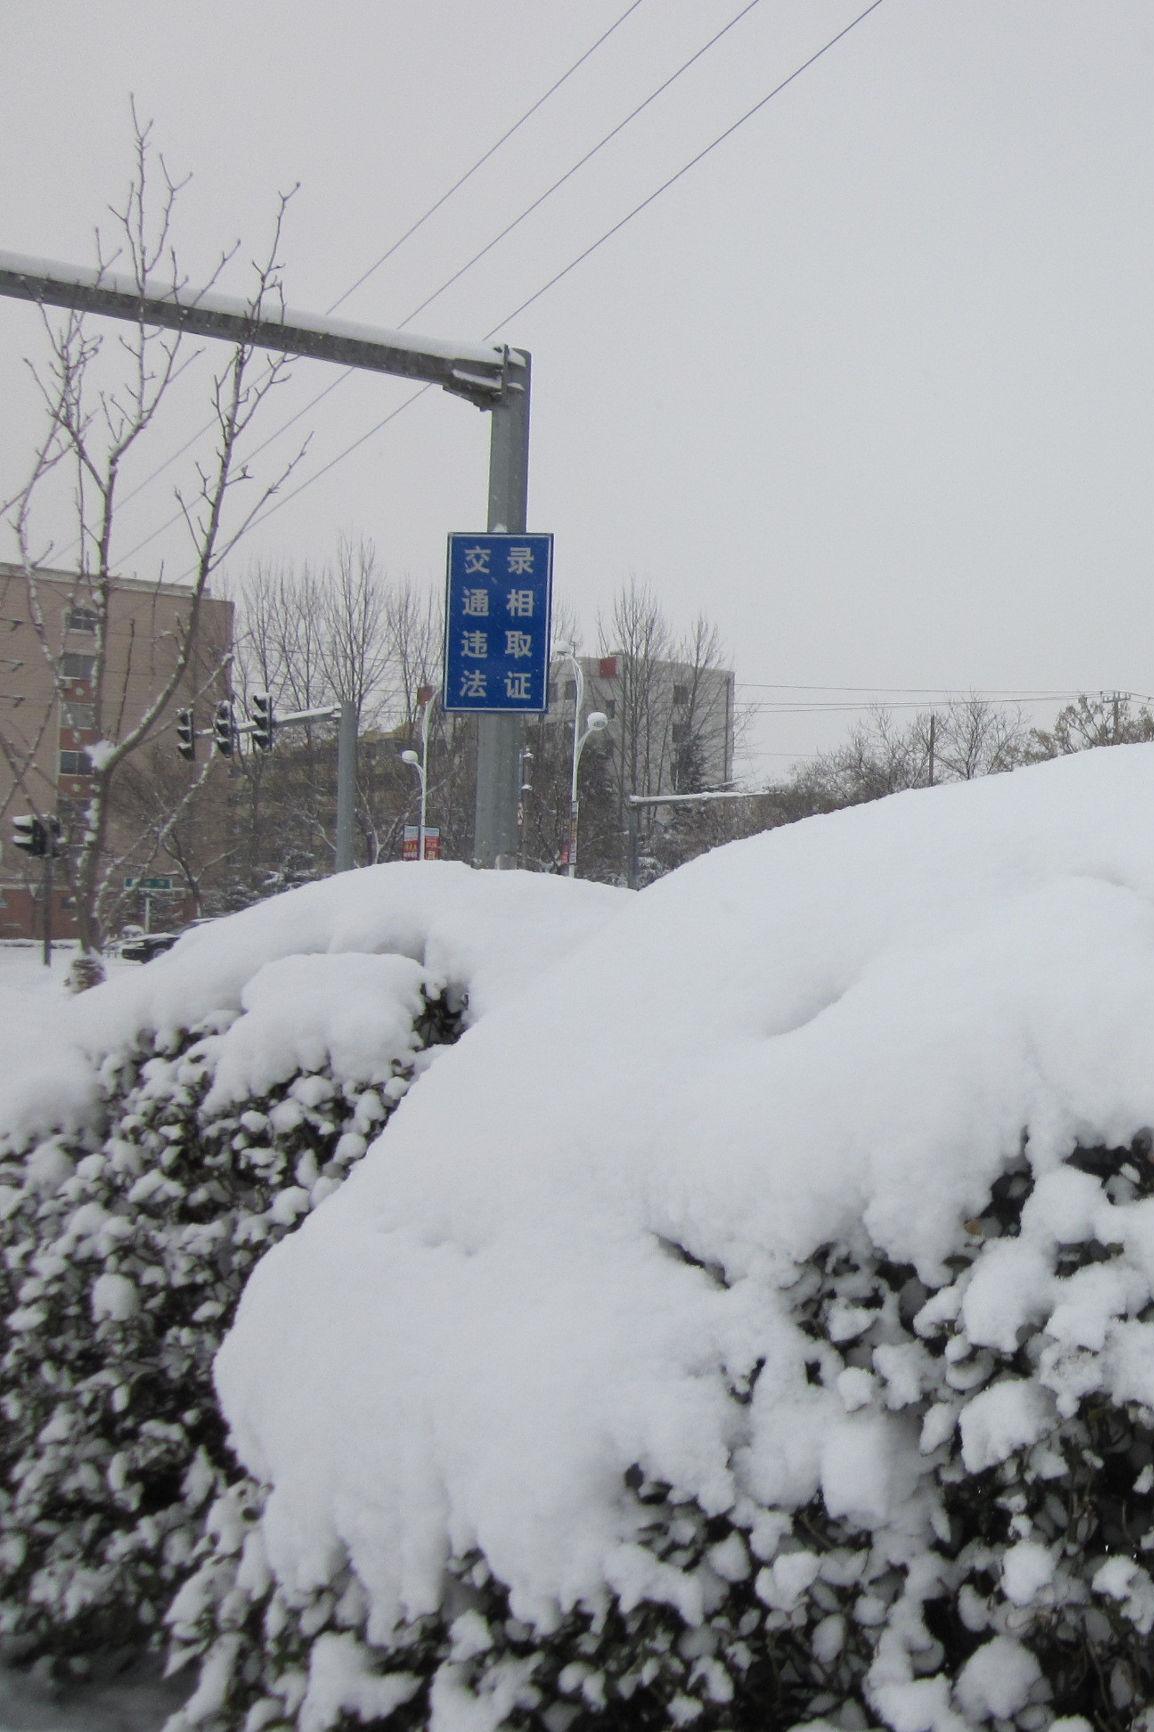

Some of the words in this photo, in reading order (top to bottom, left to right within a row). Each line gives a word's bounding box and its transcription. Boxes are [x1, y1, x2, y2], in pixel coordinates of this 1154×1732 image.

[459, 545, 492, 699] 交通违法
[504, 546, 535, 700] 录相取证
